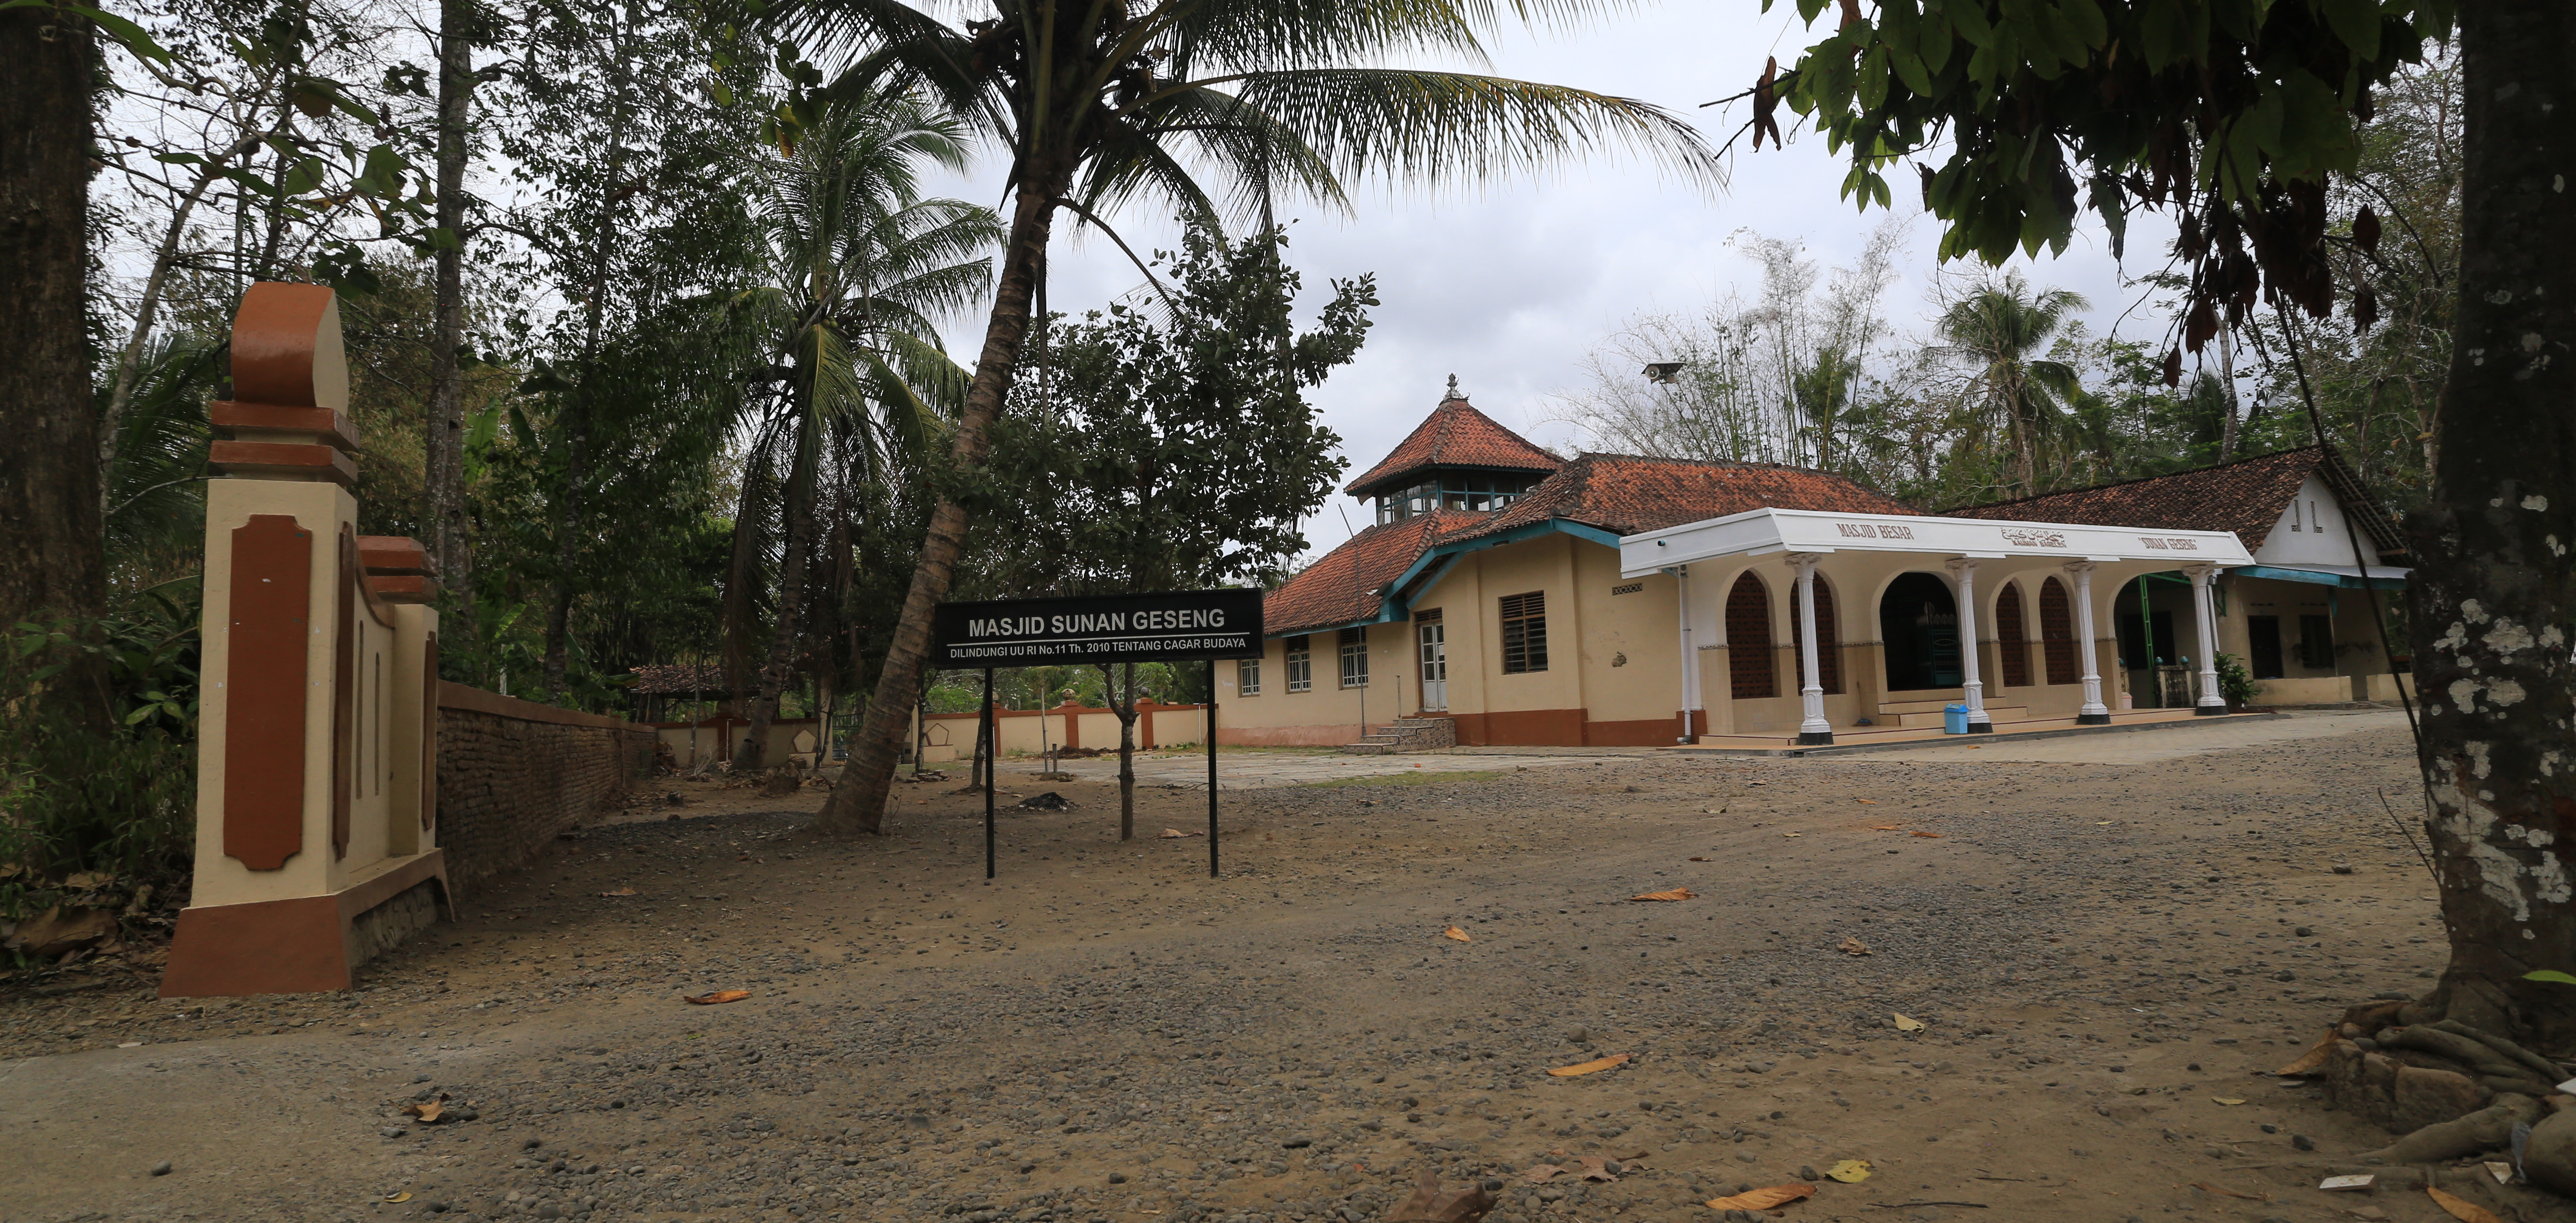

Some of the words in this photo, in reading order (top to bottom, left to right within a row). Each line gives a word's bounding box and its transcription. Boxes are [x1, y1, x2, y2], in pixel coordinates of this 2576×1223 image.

[1836, 523, 1876, 538] MASJID
[1877, 525, 1914, 539] BESAR
[969, 617, 1045, 637] MASJID
[1051, 612, 1125, 633] SUNAN
[1133, 609, 1224, 630] GESENG
[950, 646, 1007, 658] DILINDUNGI
[1010, 646, 1024, 655] UU
[1027, 645, 1036, 655] RI
[1039, 644, 1065, 654] No.11
[1069, 644, 1084, 653] Th.
[1087, 642, 1110, 652] 2010
[1112, 641, 1161, 652] TENTANG
[1164, 639, 1200, 650] CAGAR
[1204, 638, 1246, 648] BUDAYA
